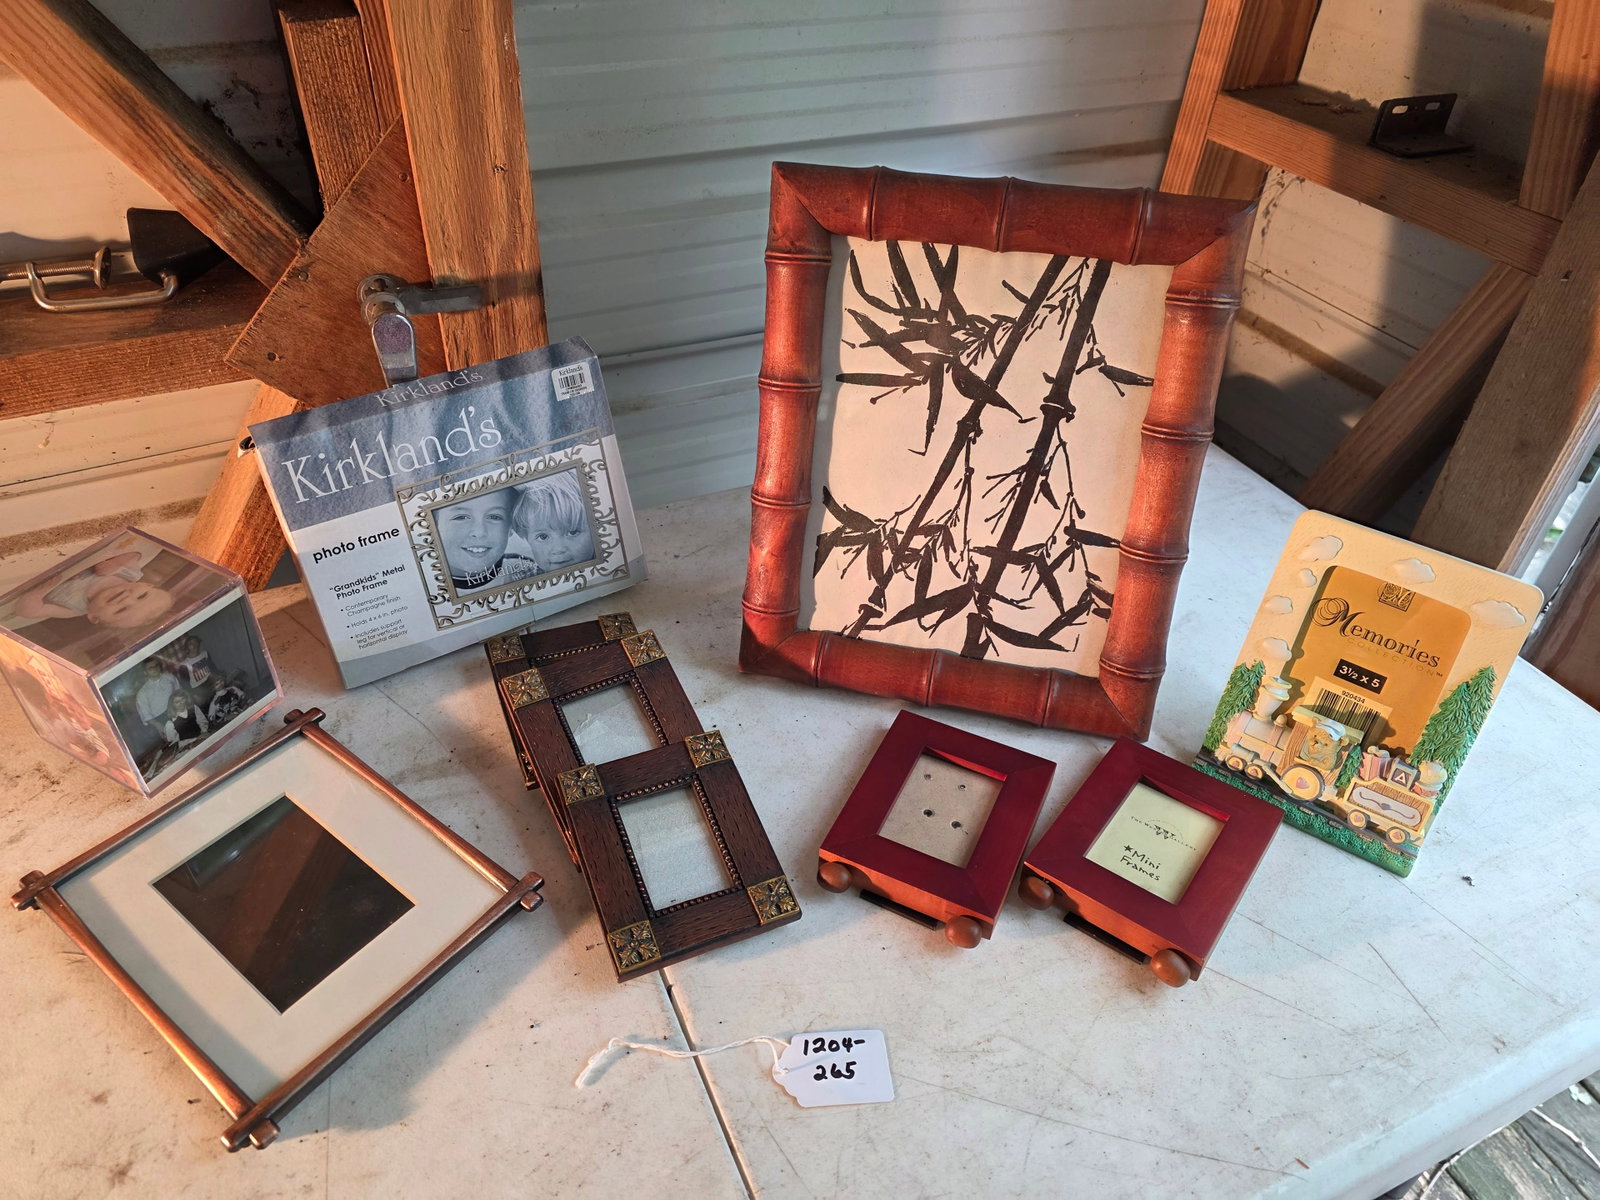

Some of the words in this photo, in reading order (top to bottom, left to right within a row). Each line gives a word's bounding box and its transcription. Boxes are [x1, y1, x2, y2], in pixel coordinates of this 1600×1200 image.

[375, 369, 484, 407] Kirkland's
[282, 405, 503, 504] Kirkland's
[438, 447, 562, 501] Grandkids
[312, 541, 356, 565] photo
[357, 527, 400, 548] frame
[382, 564, 406, 578] Metal
[336, 587, 361, 601] Photo
[361, 579, 388, 592] Frame
[345, 593, 389, 612] Contemporary
[347, 601, 386, 617] Champagne
[386, 595, 401, 604] finish
[351, 619, 368, 629] Holds
[390, 605, 408, 616] photo
[355, 626, 380, 639] Includes
[380, 618, 402, 631] support
[357, 637, 368, 645] leg
[376, 626, 398, 638] vertical
[1309, 596, 1441, 668] Memories
[358, 636, 388, 650] horizontal
[387, 629, 408, 641] display
[1371, 678, 1380, 688] 5
[1341, 690, 1366, 704] 920434
[1394, 771, 1407, 785] A
[1119, 854, 1161, 882] Frames
[1131, 850, 1161, 870] Mini
[803, 1037, 866, 1056] 1204-
[813, 1061, 857, 1081] 265
